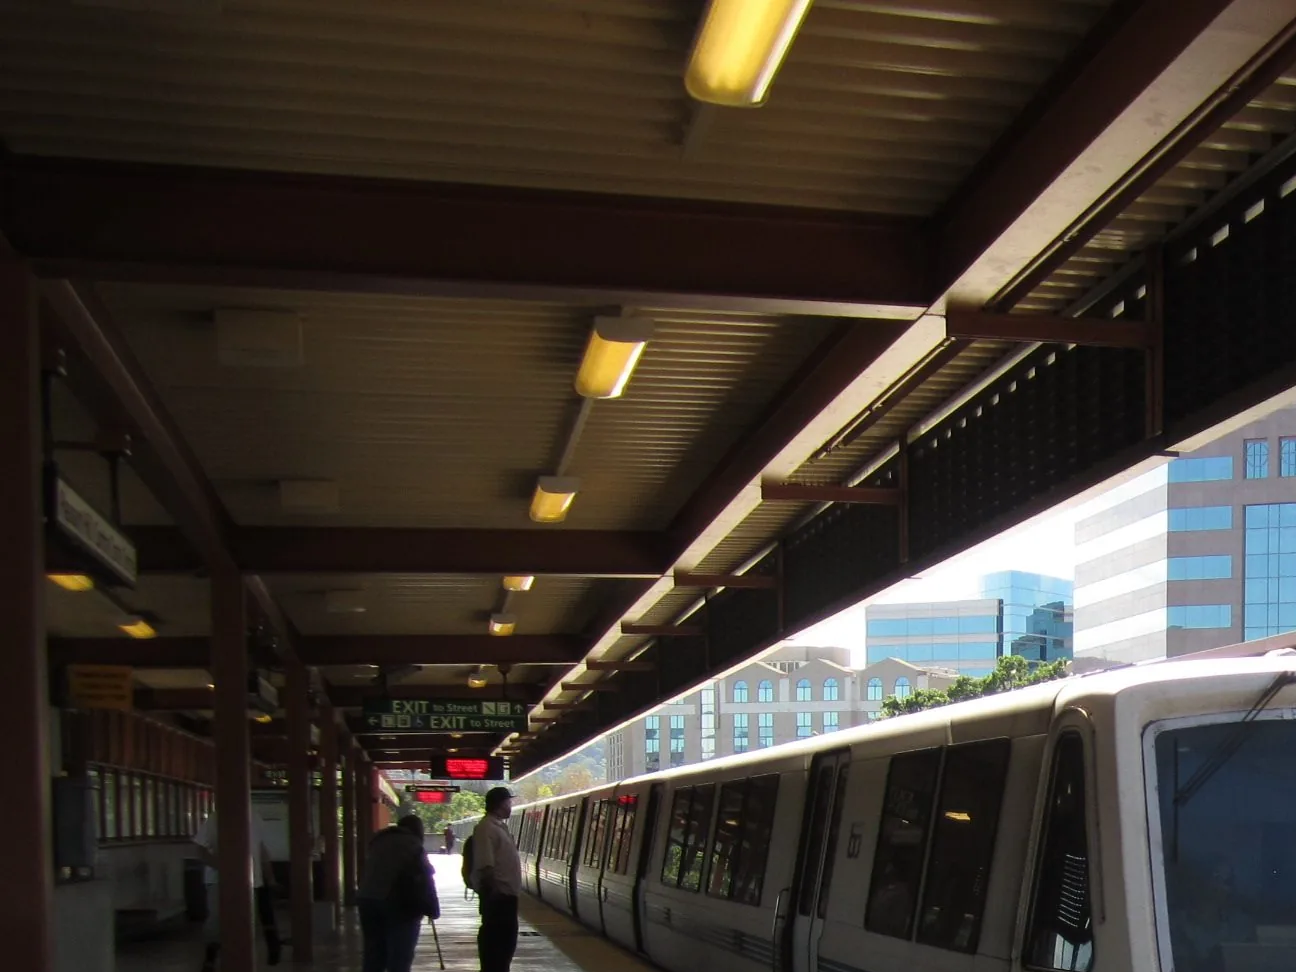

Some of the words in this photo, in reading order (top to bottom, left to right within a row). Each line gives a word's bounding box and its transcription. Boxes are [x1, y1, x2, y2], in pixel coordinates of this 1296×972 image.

[392, 700, 429, 714] EXIT
[433, 704, 445, 713] to
[446, 703, 478, 713] Street
[430, 716, 467, 729] EXIT
[470, 719, 482, 728] to
[484, 718, 515, 728] Street
